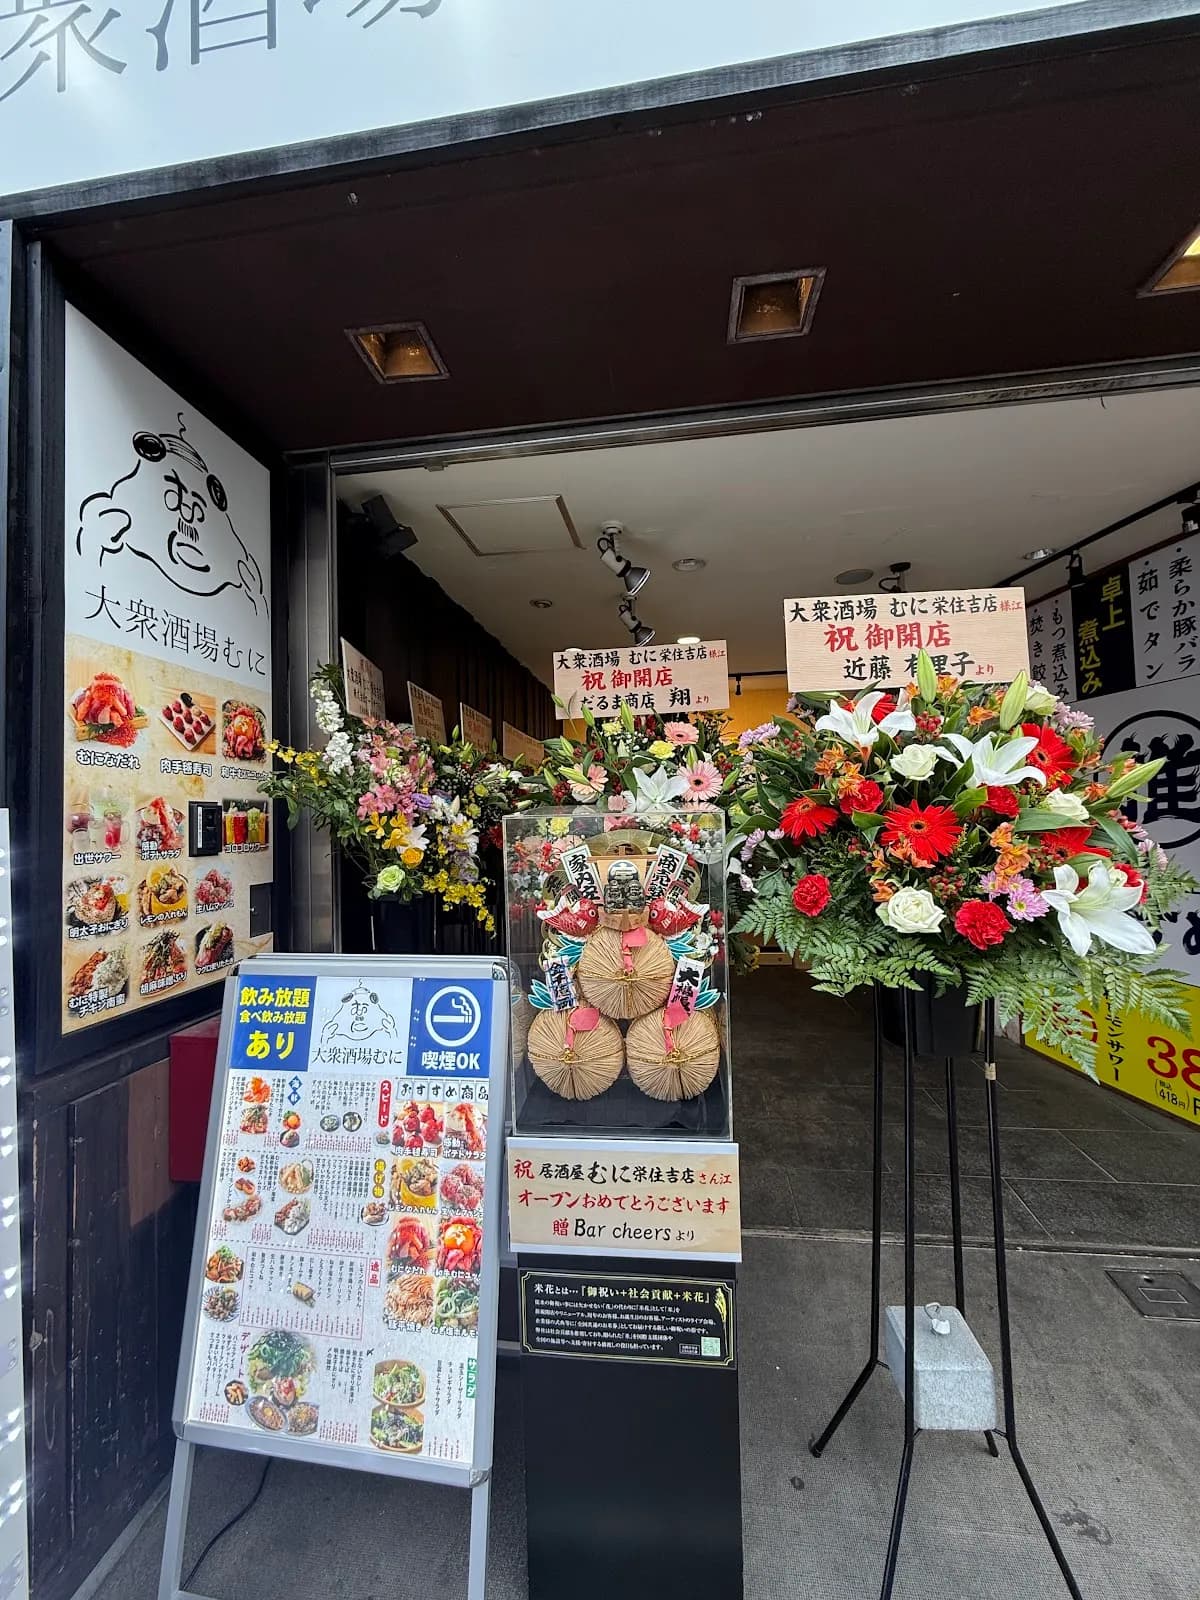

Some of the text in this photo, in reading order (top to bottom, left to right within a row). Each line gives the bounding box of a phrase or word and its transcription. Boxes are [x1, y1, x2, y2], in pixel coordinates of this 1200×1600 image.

[789, 598, 877, 623] 大衆酒場
[1101, 575, 1125, 631] 卓上
[1169, 556, 1197, 672] 柔らか豚バラ
[85, 585, 266, 676] 大衆酒場むに
[824, 620, 952, 652] 祝 御開店
[1137, 569, 1164, 679] 茹でタン
[556, 650, 621, 669] 大衆酒場
[1030, 616, 1047, 681] 焚き餃
[1078, 618, 1102, 694] 煮込み
[582, 666, 673, 691] 祝 御開店
[843, 655, 892, 680] 近藤
[76, 749, 141, 770] むになだれ
[73, 852, 121, 866] 出世サワー
[569, 853, 601, 902] 家内安
[69, 916, 129, 938] 明太子おにぎり
[68, 988, 109, 1009] むに特製
[79, 993, 126, 1018] チキン南蛮
[240, 986, 310, 1008] 飲み放題
[239, 1009, 306, 1025] 食べ飲み放題
[245, 1029, 296, 1060] あり
[311, 1047, 402, 1065] 大衆酒場むに
[421, 1050, 480, 1071] 喫煙OK
[379, 1082, 391, 1125] スピード
[513, 1159, 535, 1180] 祝
[517, 1189, 731, 1217] オープンおめでとうございます
[552, 1218, 696, 1242] 贈 Bar cheers より
[238, 1331, 251, 1378] デザート
